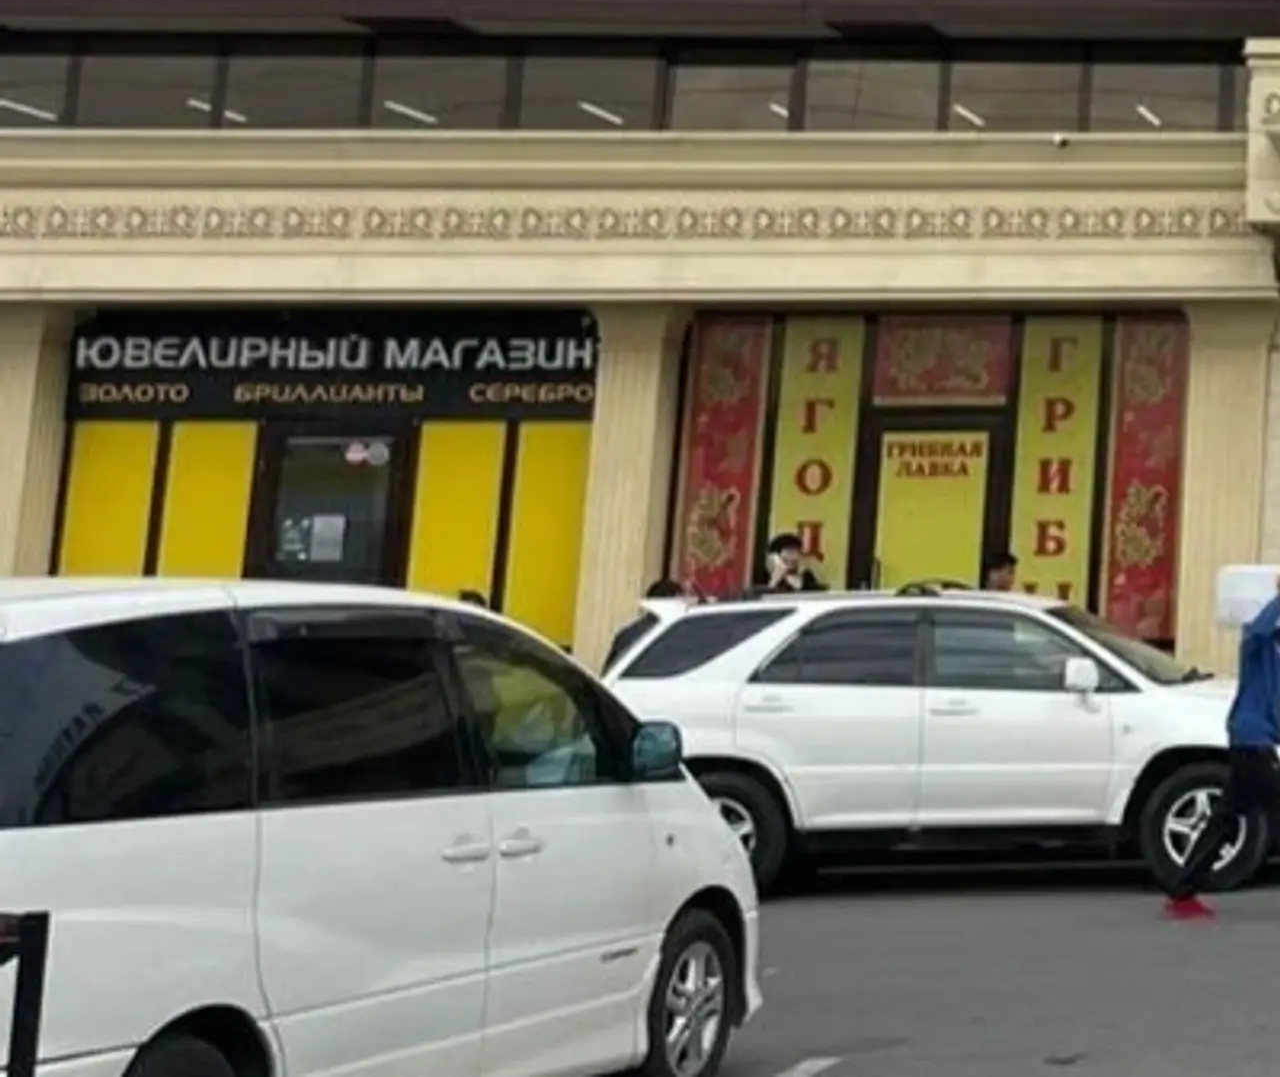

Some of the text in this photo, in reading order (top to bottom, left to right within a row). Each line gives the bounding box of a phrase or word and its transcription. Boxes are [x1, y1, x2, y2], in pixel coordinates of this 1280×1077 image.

[75, 334, 594, 370] ЮВЕЛИРНЫЙ МАГАЗИН
[79, 381, 594, 404] ЗОЛОТО БРИЛЛИАНТЫ СЕРЕБРО
[795, 336, 841, 586] ЯГОД
[896, 460, 970, 478] ЛАВКА
